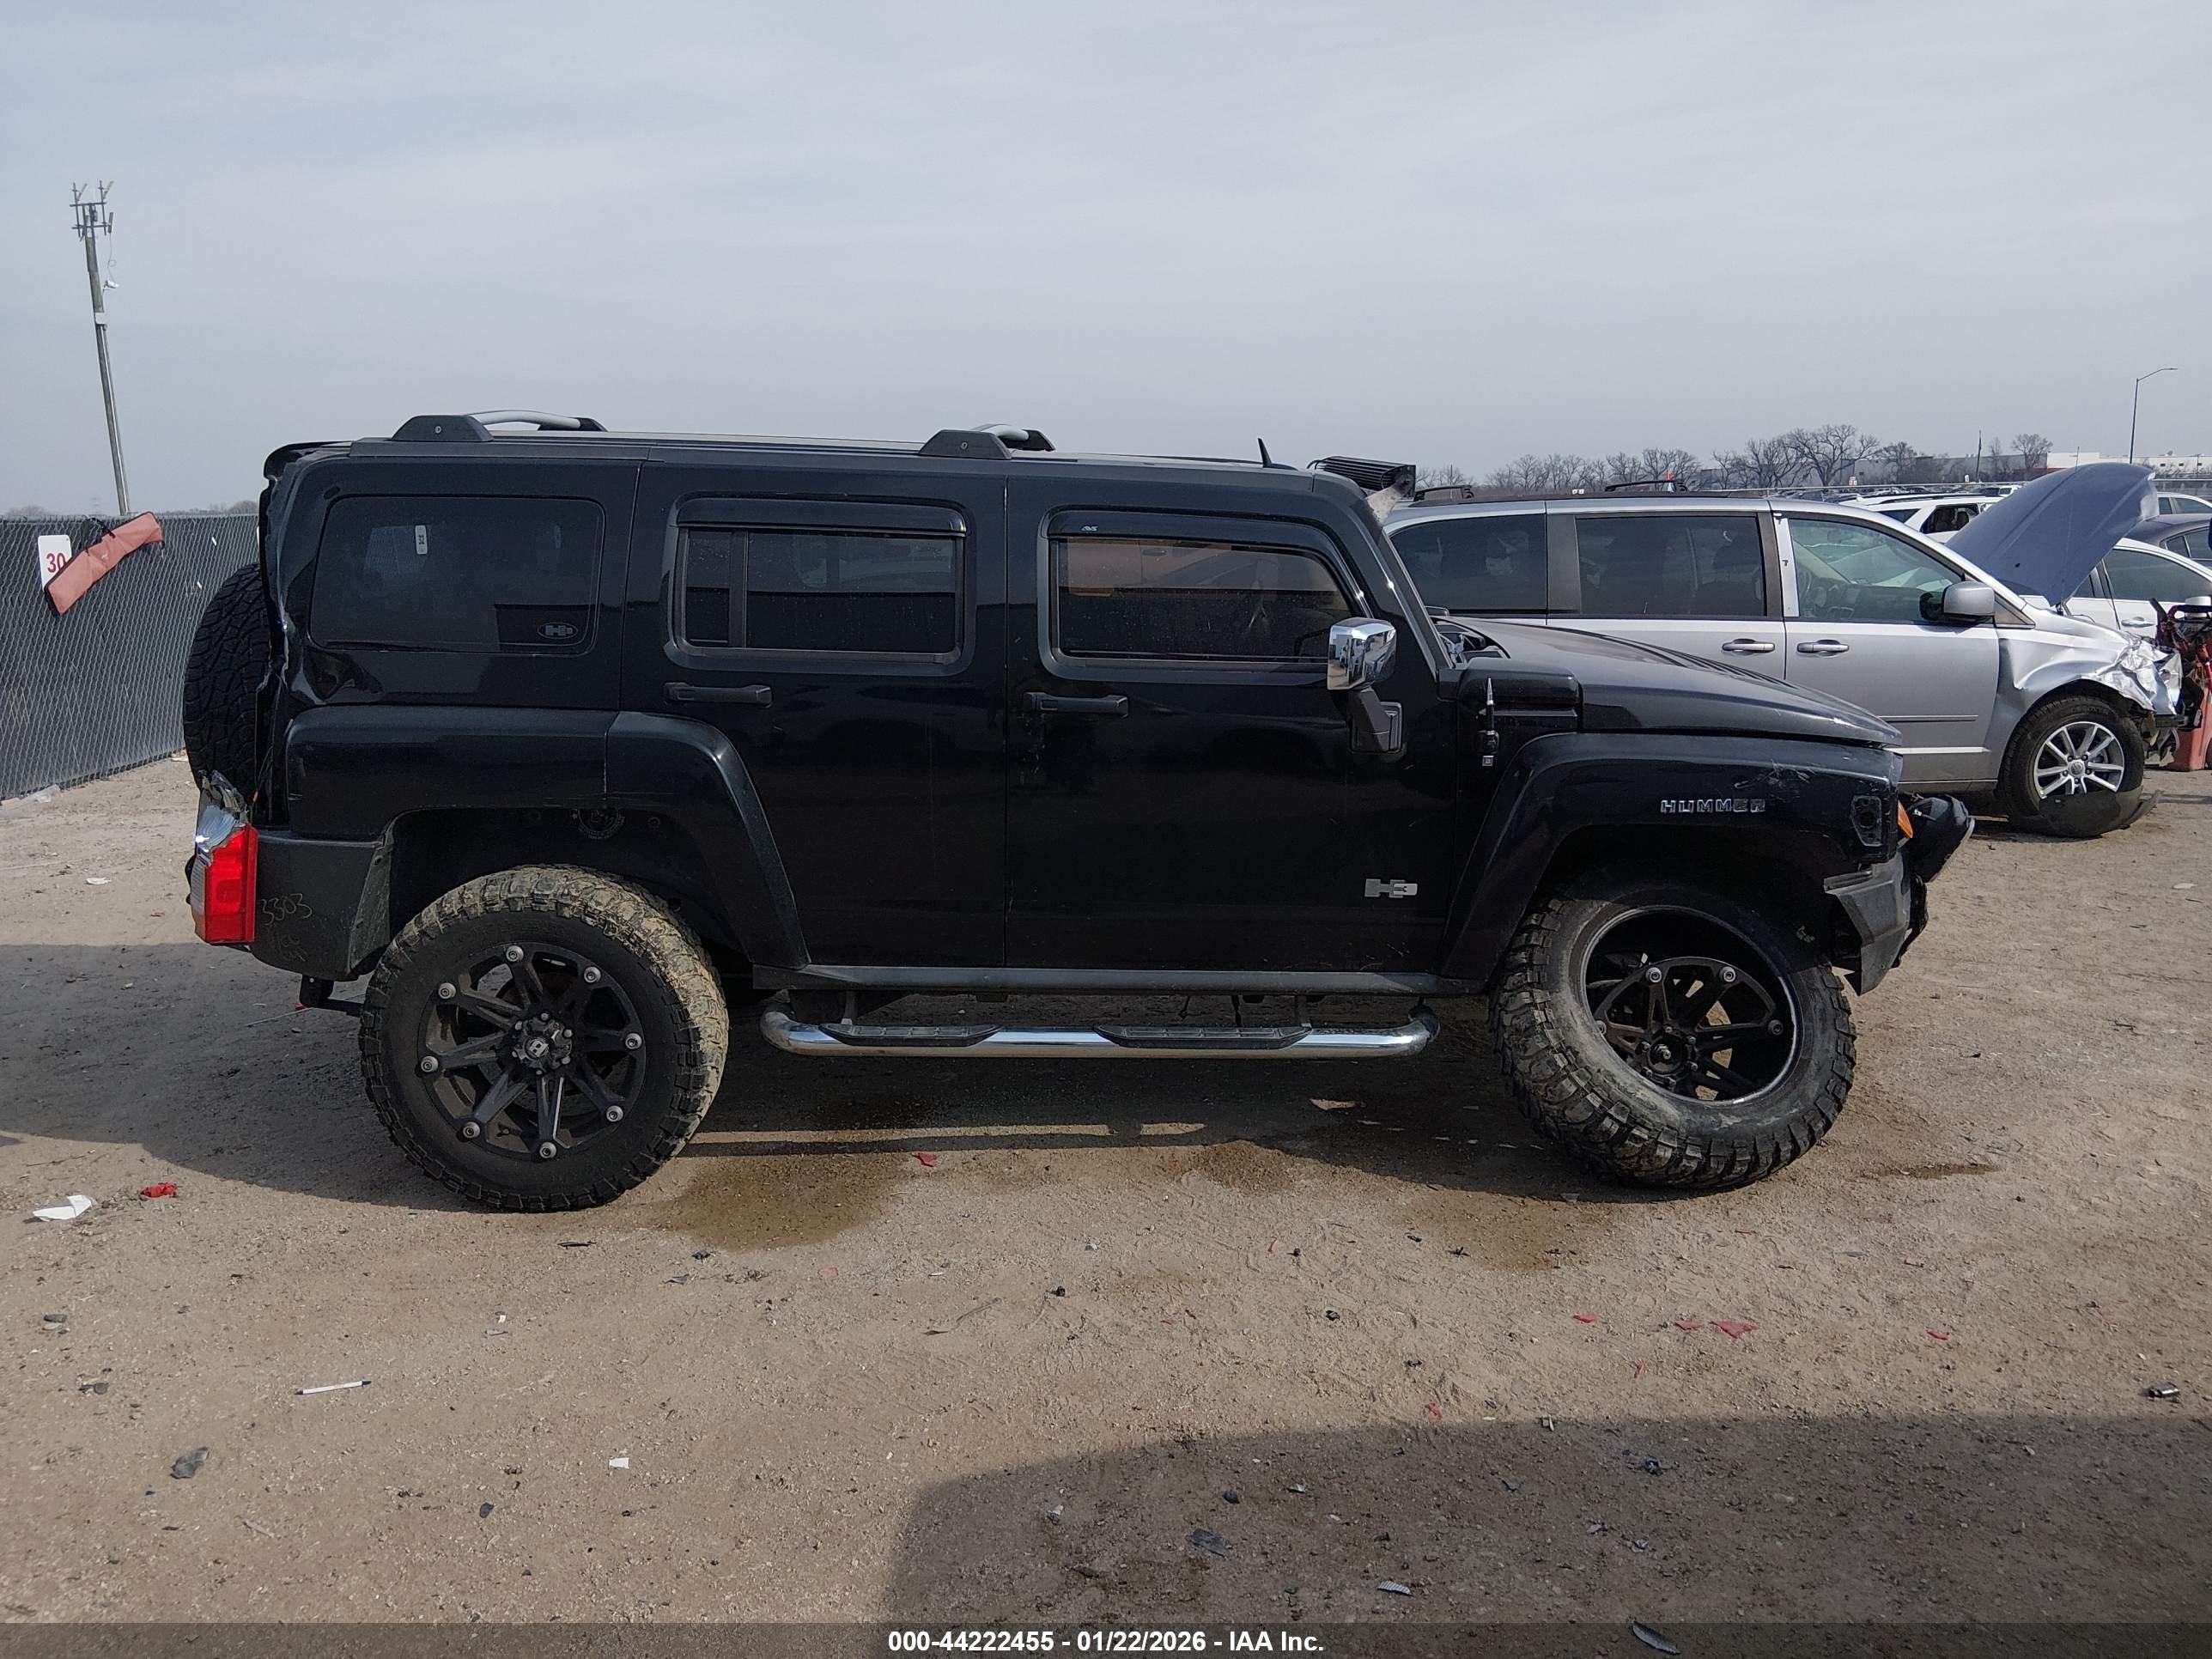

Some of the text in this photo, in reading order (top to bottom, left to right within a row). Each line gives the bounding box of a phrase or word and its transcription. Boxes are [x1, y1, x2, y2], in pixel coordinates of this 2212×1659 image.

[46, 552, 68, 574] 30
[1660, 799, 1766, 814] HUMMER
[259, 892, 313, 927] 3303
